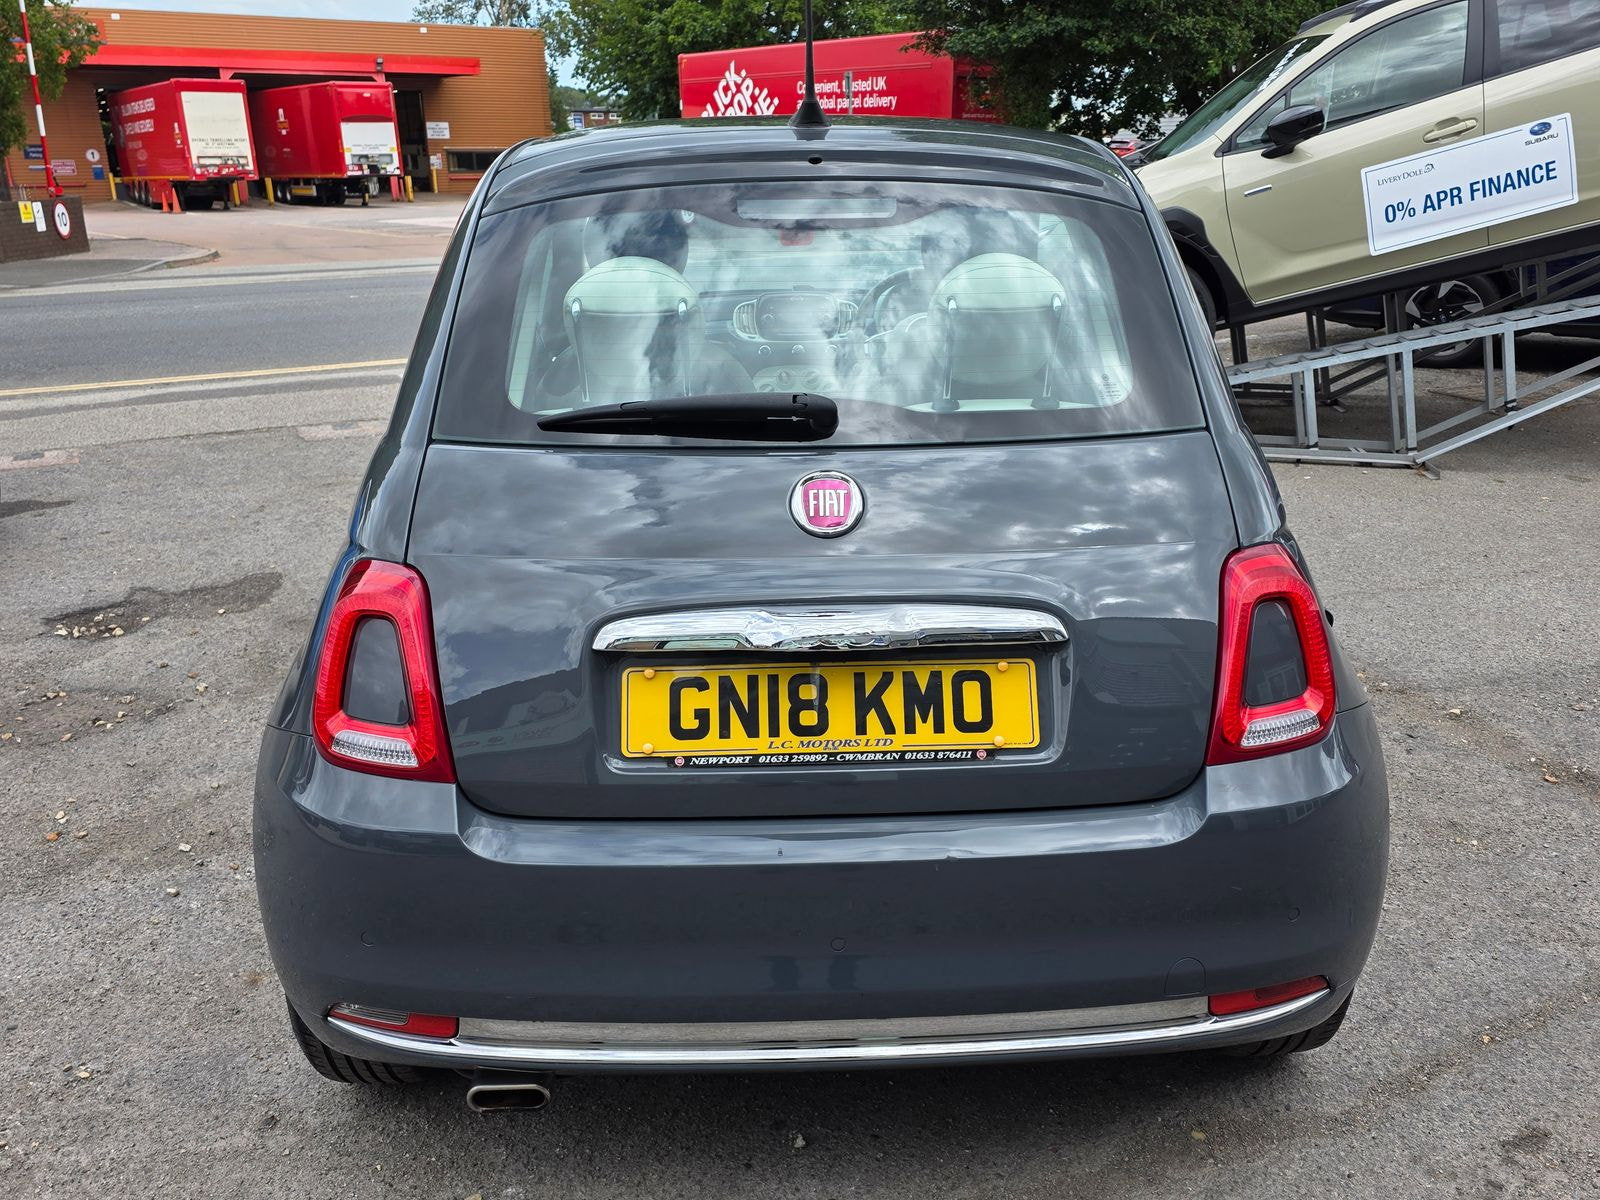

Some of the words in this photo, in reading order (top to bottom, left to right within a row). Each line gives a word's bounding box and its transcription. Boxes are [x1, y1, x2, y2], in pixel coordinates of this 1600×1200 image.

[873, 76, 887, 90] UK
[863, 93, 898, 111] delivery
[1524, 132, 1559, 147] SUBARU
[1384, 198, 1416, 224] 0%
[1422, 186, 1463, 215] APR
[1469, 160, 1558, 202] FINANCE
[57, 212, 68, 228] 10
[808, 489, 848, 517] FIAT
[669, 672, 830, 741] GN18
[853, 669, 994, 736] KMO
[768, 740, 793, 749] L.C.
[797, 739, 861, 749] MOTORS
[863, 738, 894, 748] LTD
[689, 755, 753, 766] NEWPORT
[758, 754, 790, 764] 01633
[790, 754, 828, 763] 259892
[836, 752, 901, 762] CWMBRAN
[904, 751, 935, 760] 01633
[936, 750, 972, 760] 876411
